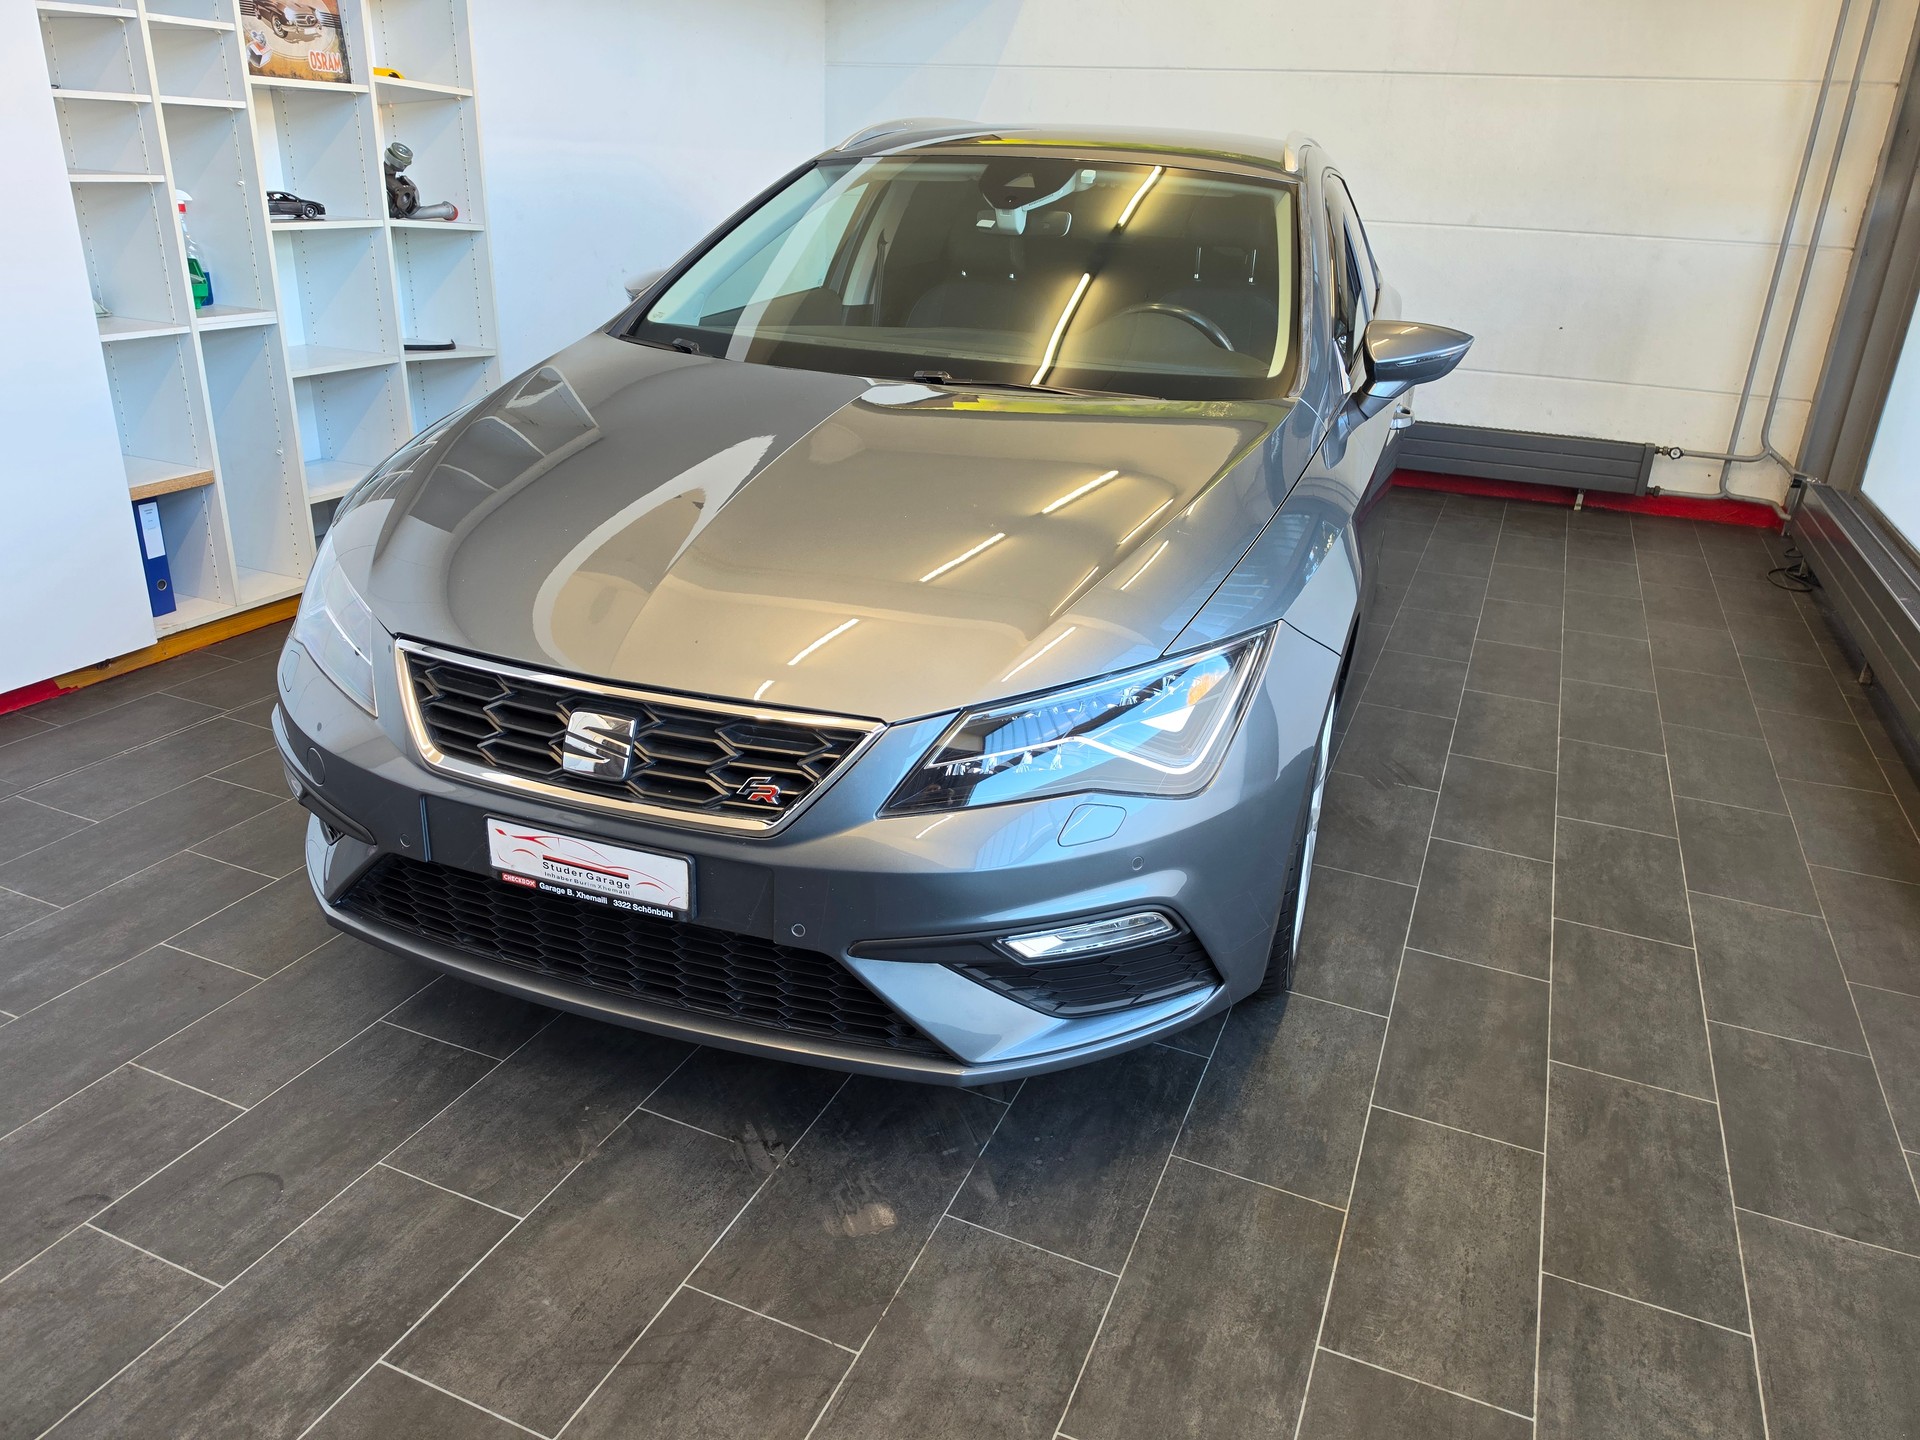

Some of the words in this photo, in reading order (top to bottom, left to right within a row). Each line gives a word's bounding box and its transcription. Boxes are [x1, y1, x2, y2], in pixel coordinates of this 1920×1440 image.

[309, 51, 343, 72] OSRAM
[736, 776, 781, 805] FR
[503, 874, 536, 888] CHECKBOX
[542, 861, 583, 878] Studer
[586, 872, 631, 889] Garage
[544, 871, 573, 883] Inhaber
[539, 882, 566, 895] Garage
[567, 888, 575, 897] B.
[613, 899, 632, 910] 3322
[632, 903, 674, 918] Schönbühl
